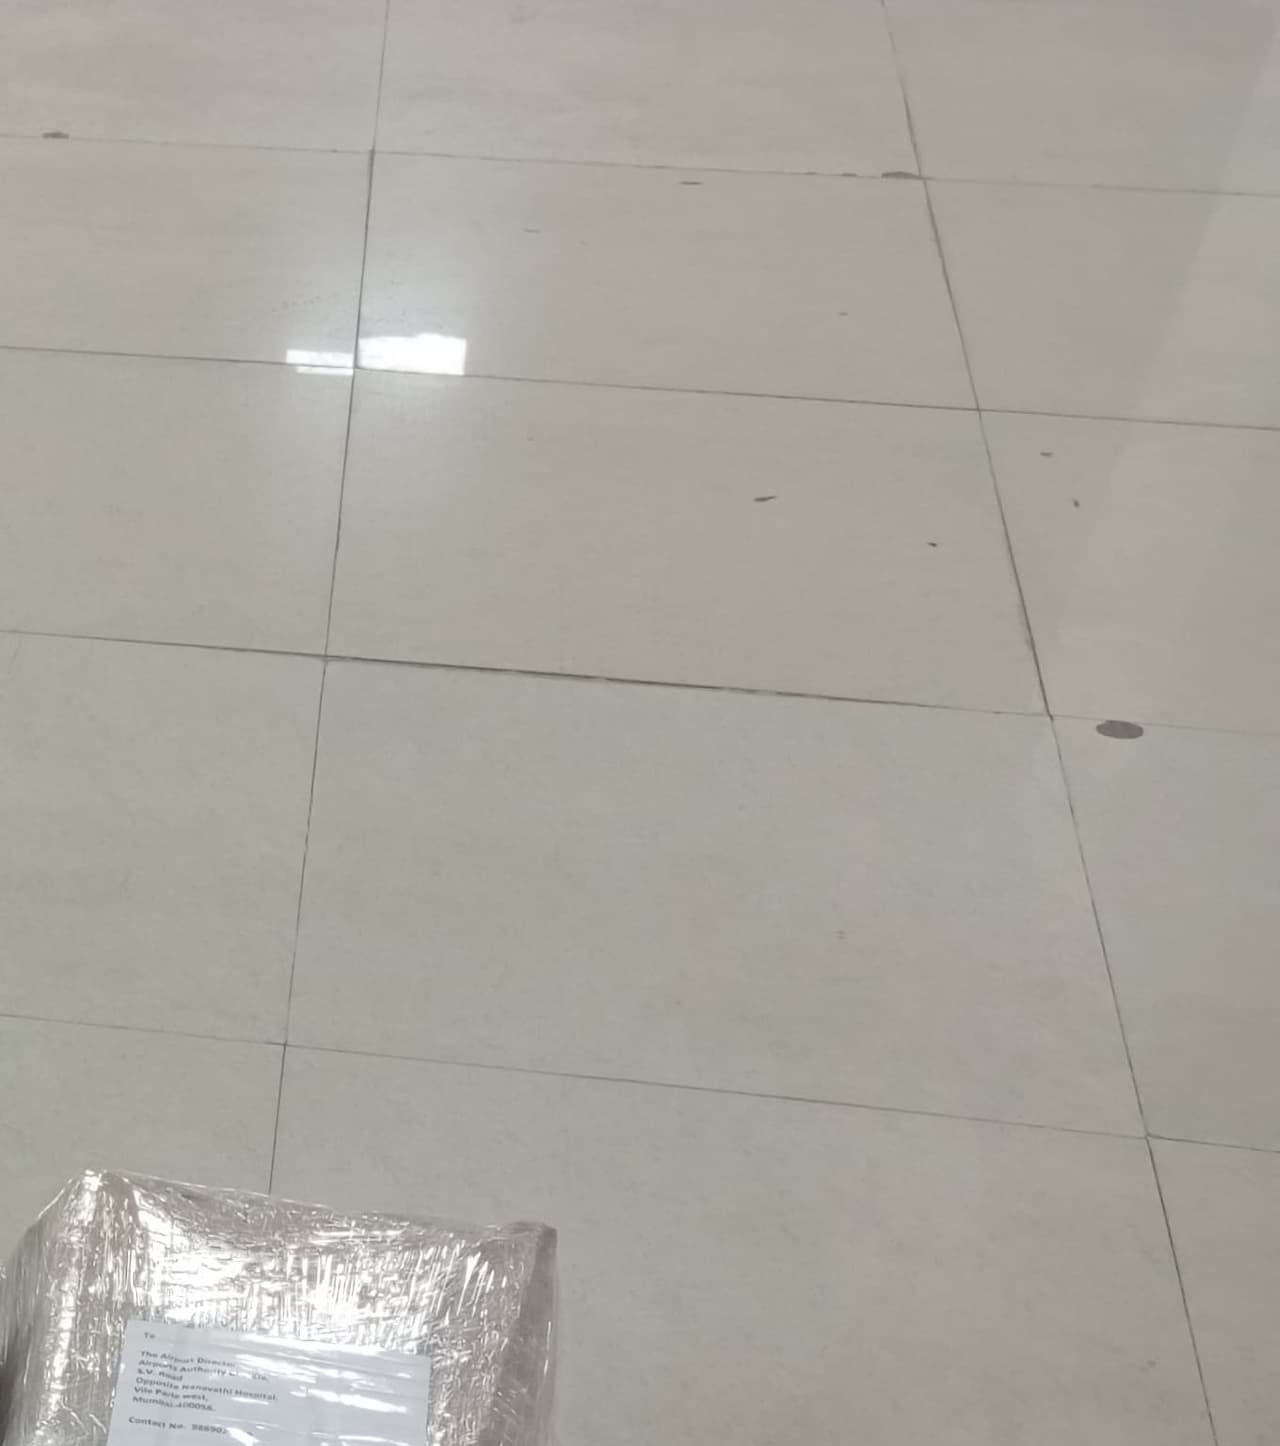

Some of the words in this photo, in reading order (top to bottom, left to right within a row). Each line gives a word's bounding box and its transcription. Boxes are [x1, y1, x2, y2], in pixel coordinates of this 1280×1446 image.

[160, 1353, 194, 1363] Airport
[136, 1377, 179, 1389] Opposite
[129, 1417, 166, 1428] Contact
